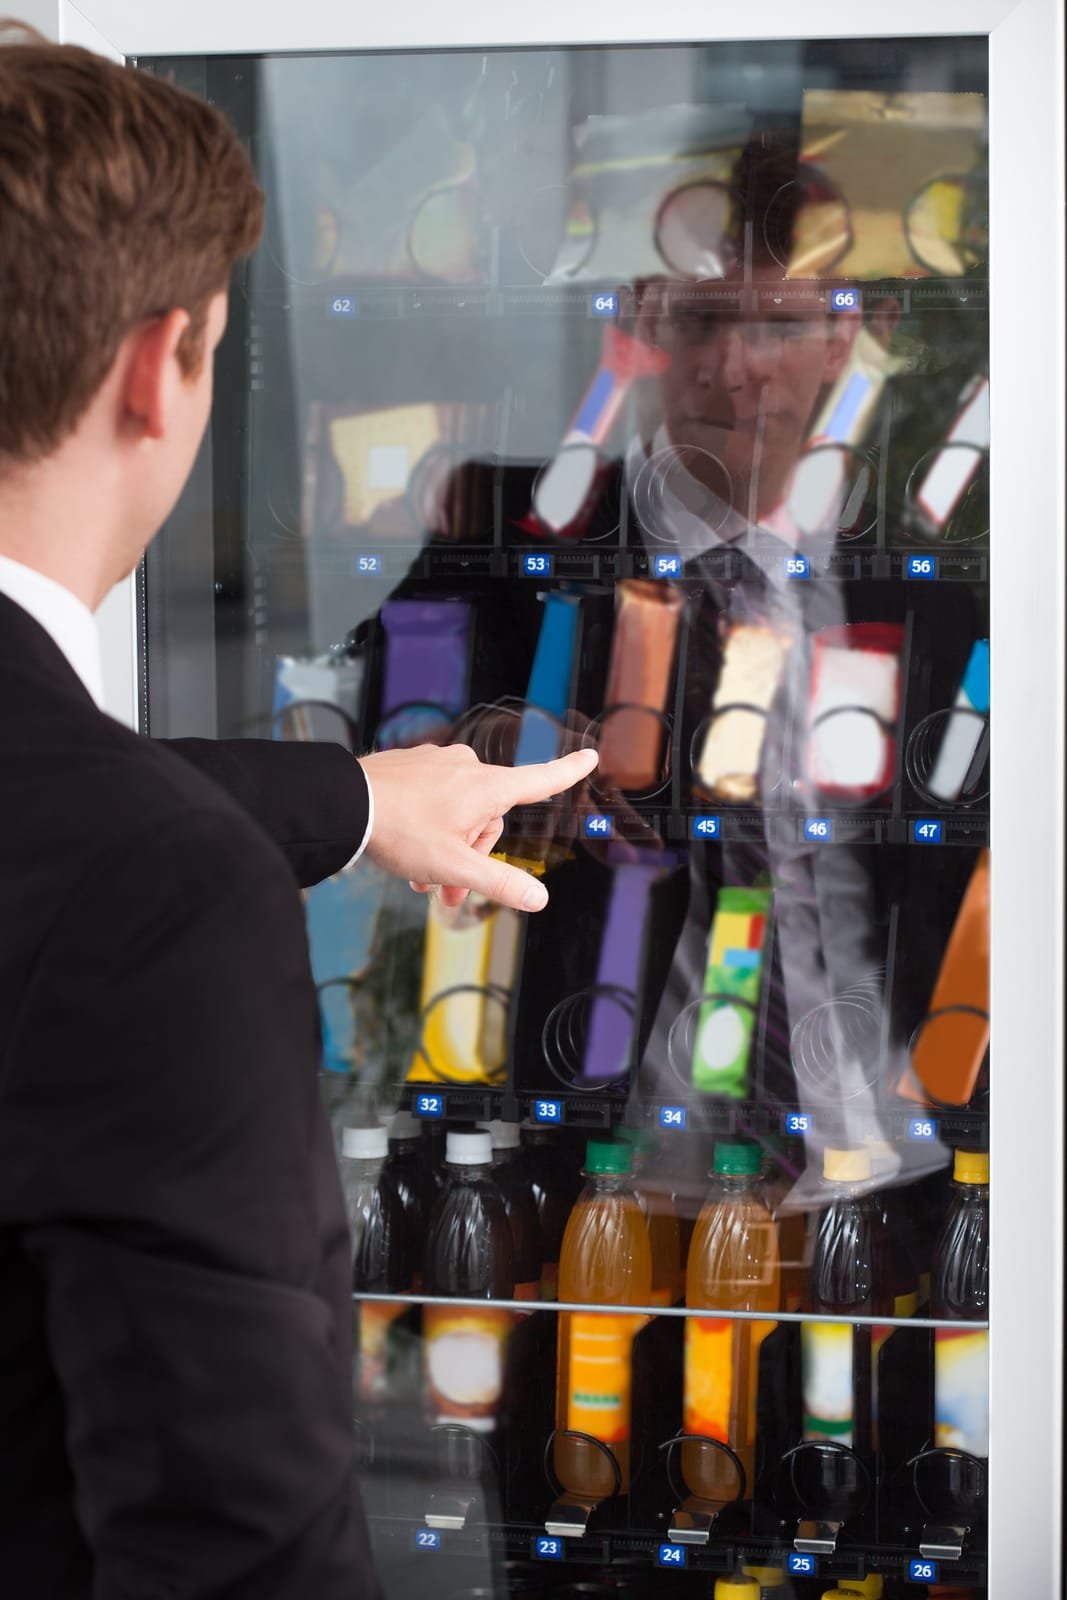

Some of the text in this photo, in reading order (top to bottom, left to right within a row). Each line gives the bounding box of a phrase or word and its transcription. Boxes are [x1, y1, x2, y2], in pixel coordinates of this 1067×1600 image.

[332, 299, 351, 313] 62
[595, 297, 614, 311] 64
[835, 292, 855, 306] 66
[359, 557, 377, 571] 52
[527, 557, 545, 571] 53
[658, 559, 677, 573] 54
[786, 559, 805, 574] 55
[912, 559, 931, 573] 56
[589, 818, 608, 832] 44
[697, 820, 716, 833] 45
[808, 822, 827, 836] 46
[918, 824, 938, 838] 47
[420, 1097, 438, 1112] 32
[539, 1102, 556, 1117] 33
[663, 1110, 682, 1124] 34
[790, 1116, 808, 1131] 35
[913, 1122, 932, 1137] 36
[419, 1532, 436, 1546] 22
[540, 1540, 557, 1554] 23
[663, 1548, 681, 1562] 24
[792, 1557, 810, 1571] 25
[914, 1564, 932, 1578] 26
